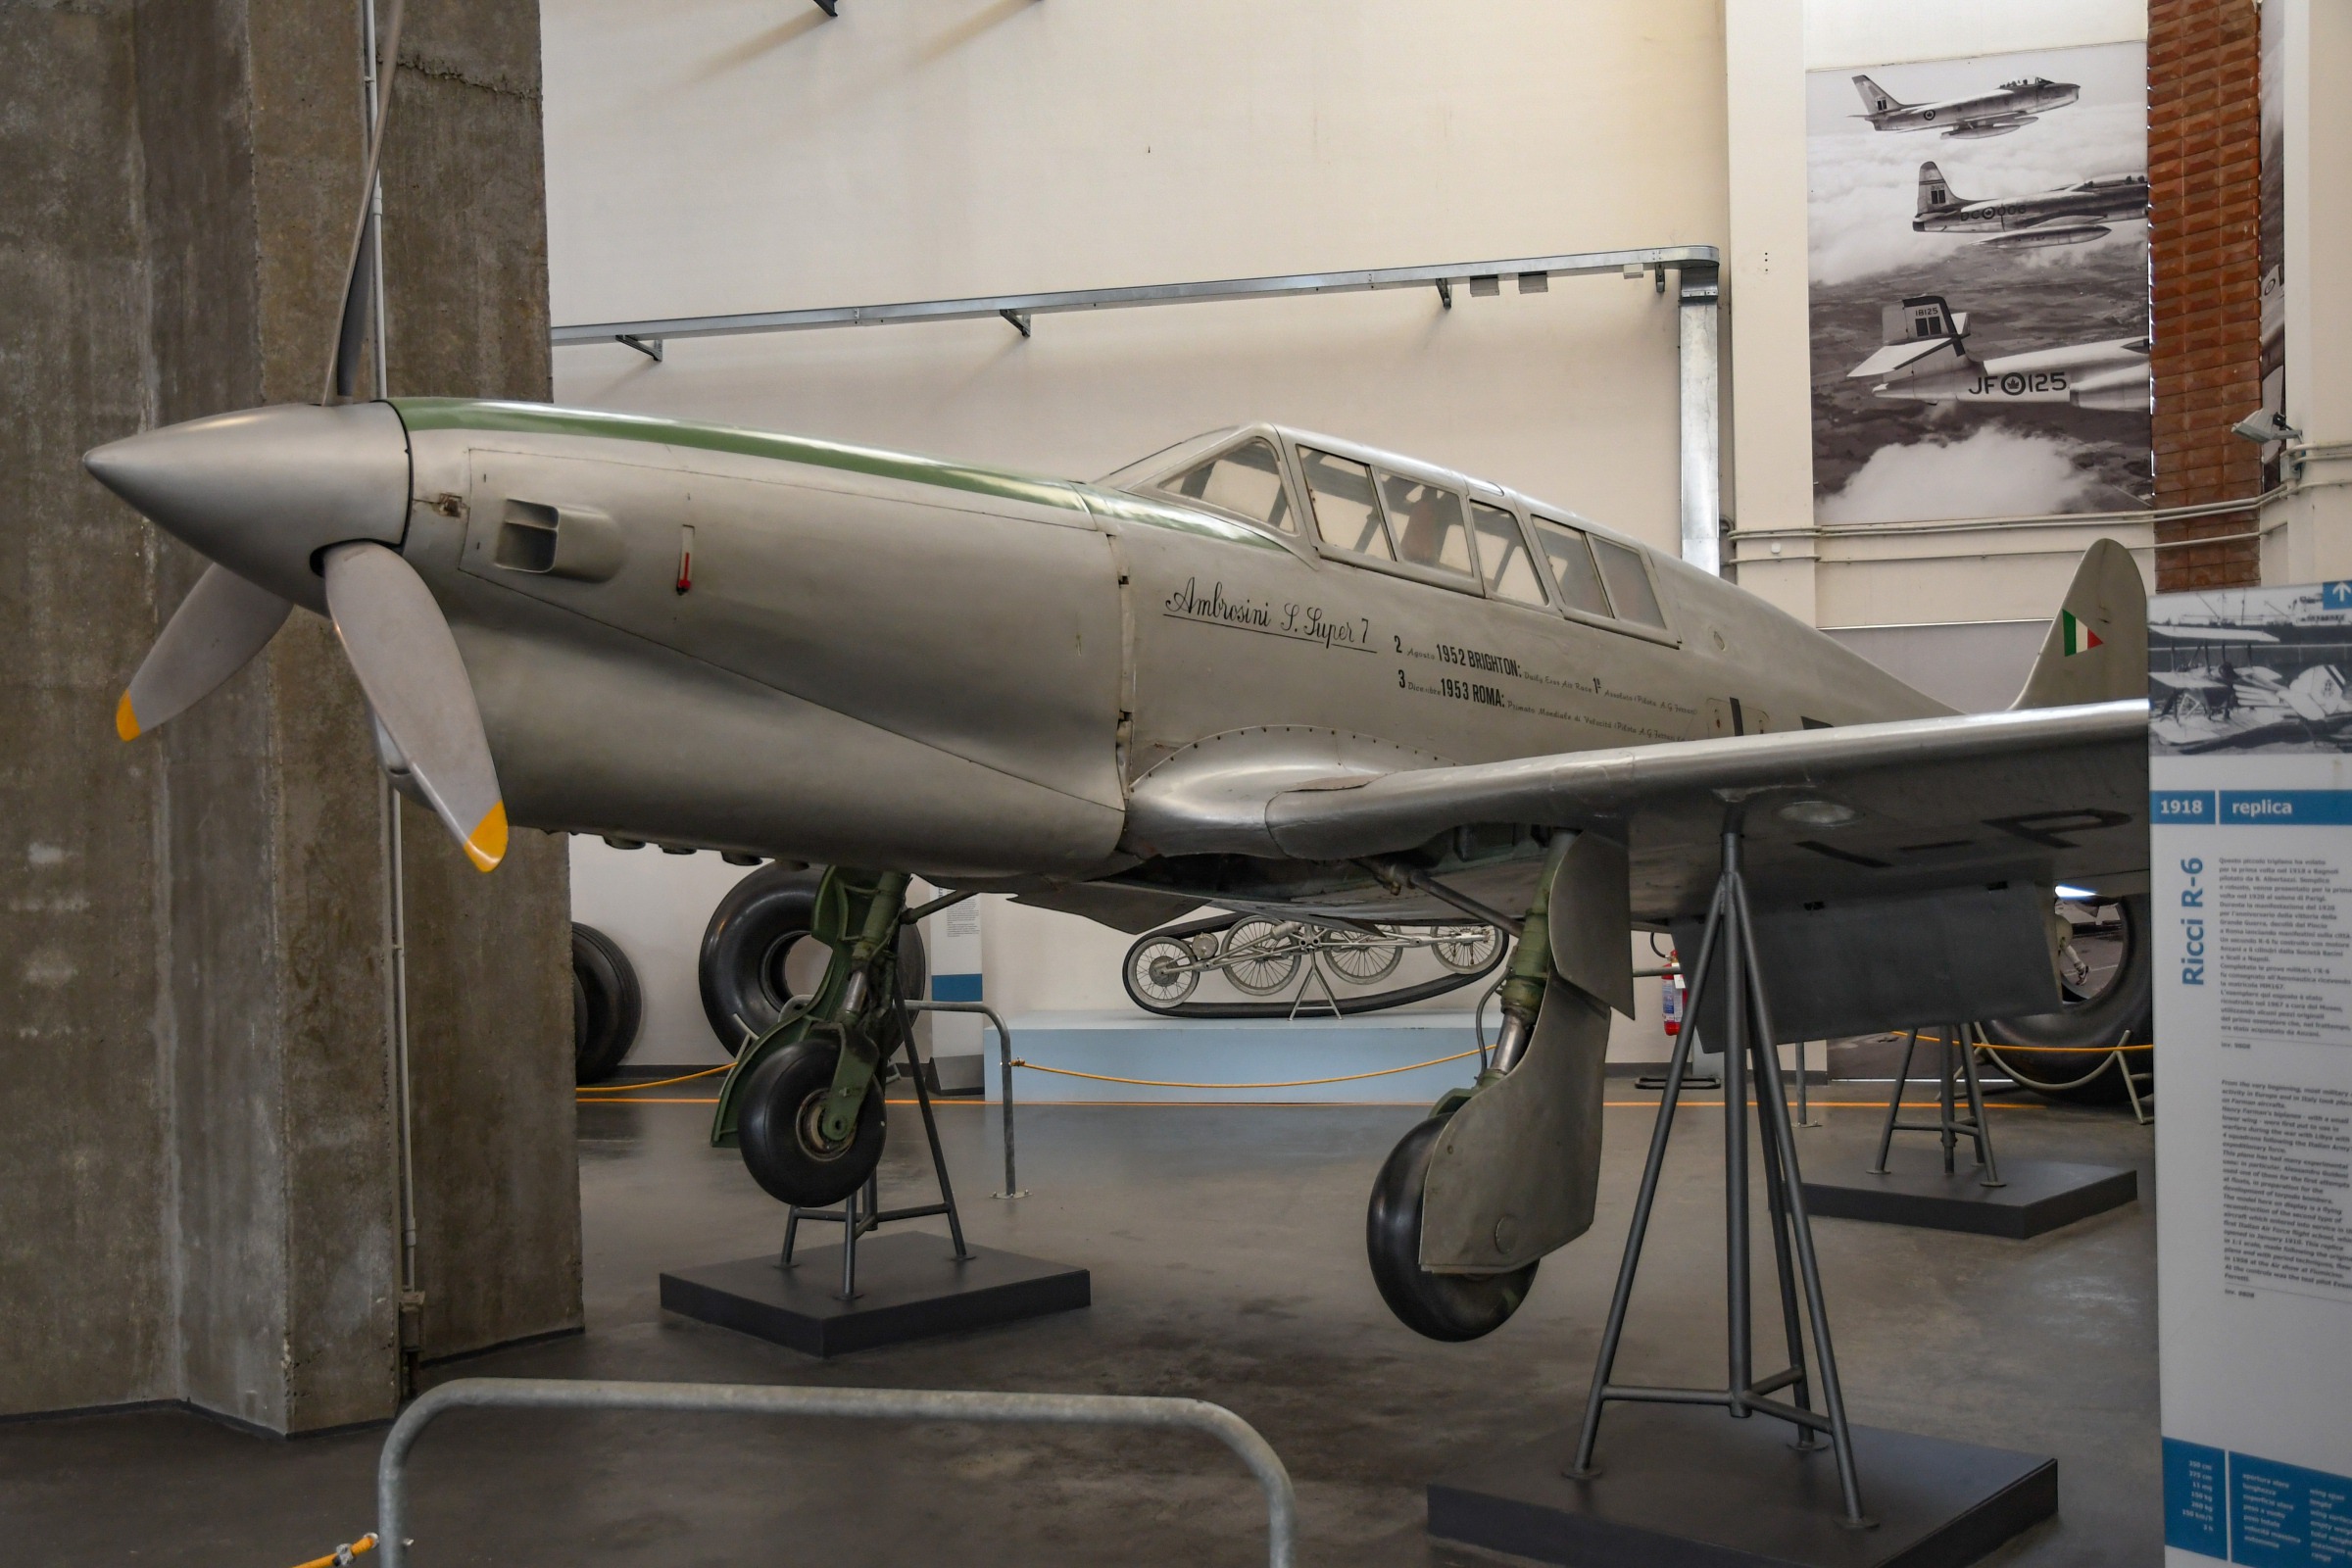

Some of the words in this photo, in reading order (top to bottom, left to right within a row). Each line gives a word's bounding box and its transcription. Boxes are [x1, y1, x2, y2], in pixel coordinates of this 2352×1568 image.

[1968, 375, 1998, 395] JF
[2029, 371, 2067, 393] 125
[1165, 576, 1271, 627] Ambrosini
[1303, 606, 1354, 649] Super
[1361, 617, 1369, 644] 7
[1394, 635, 1402, 654] 2
[1436, 644, 1466, 666] 1952
[1467, 650, 1522, 678] BRIGHTON:
[1397, 669, 1405, 689] 3
[1441, 678, 1469, 701] 1953
[1472, 683, 1505, 708] ROMA:
[2160, 800, 2203, 814] 1918
[2231, 800, 2292, 817] replica
[2180, 857, 2204, 907] R-6
[2180, 918, 2204, 986] Ricci
